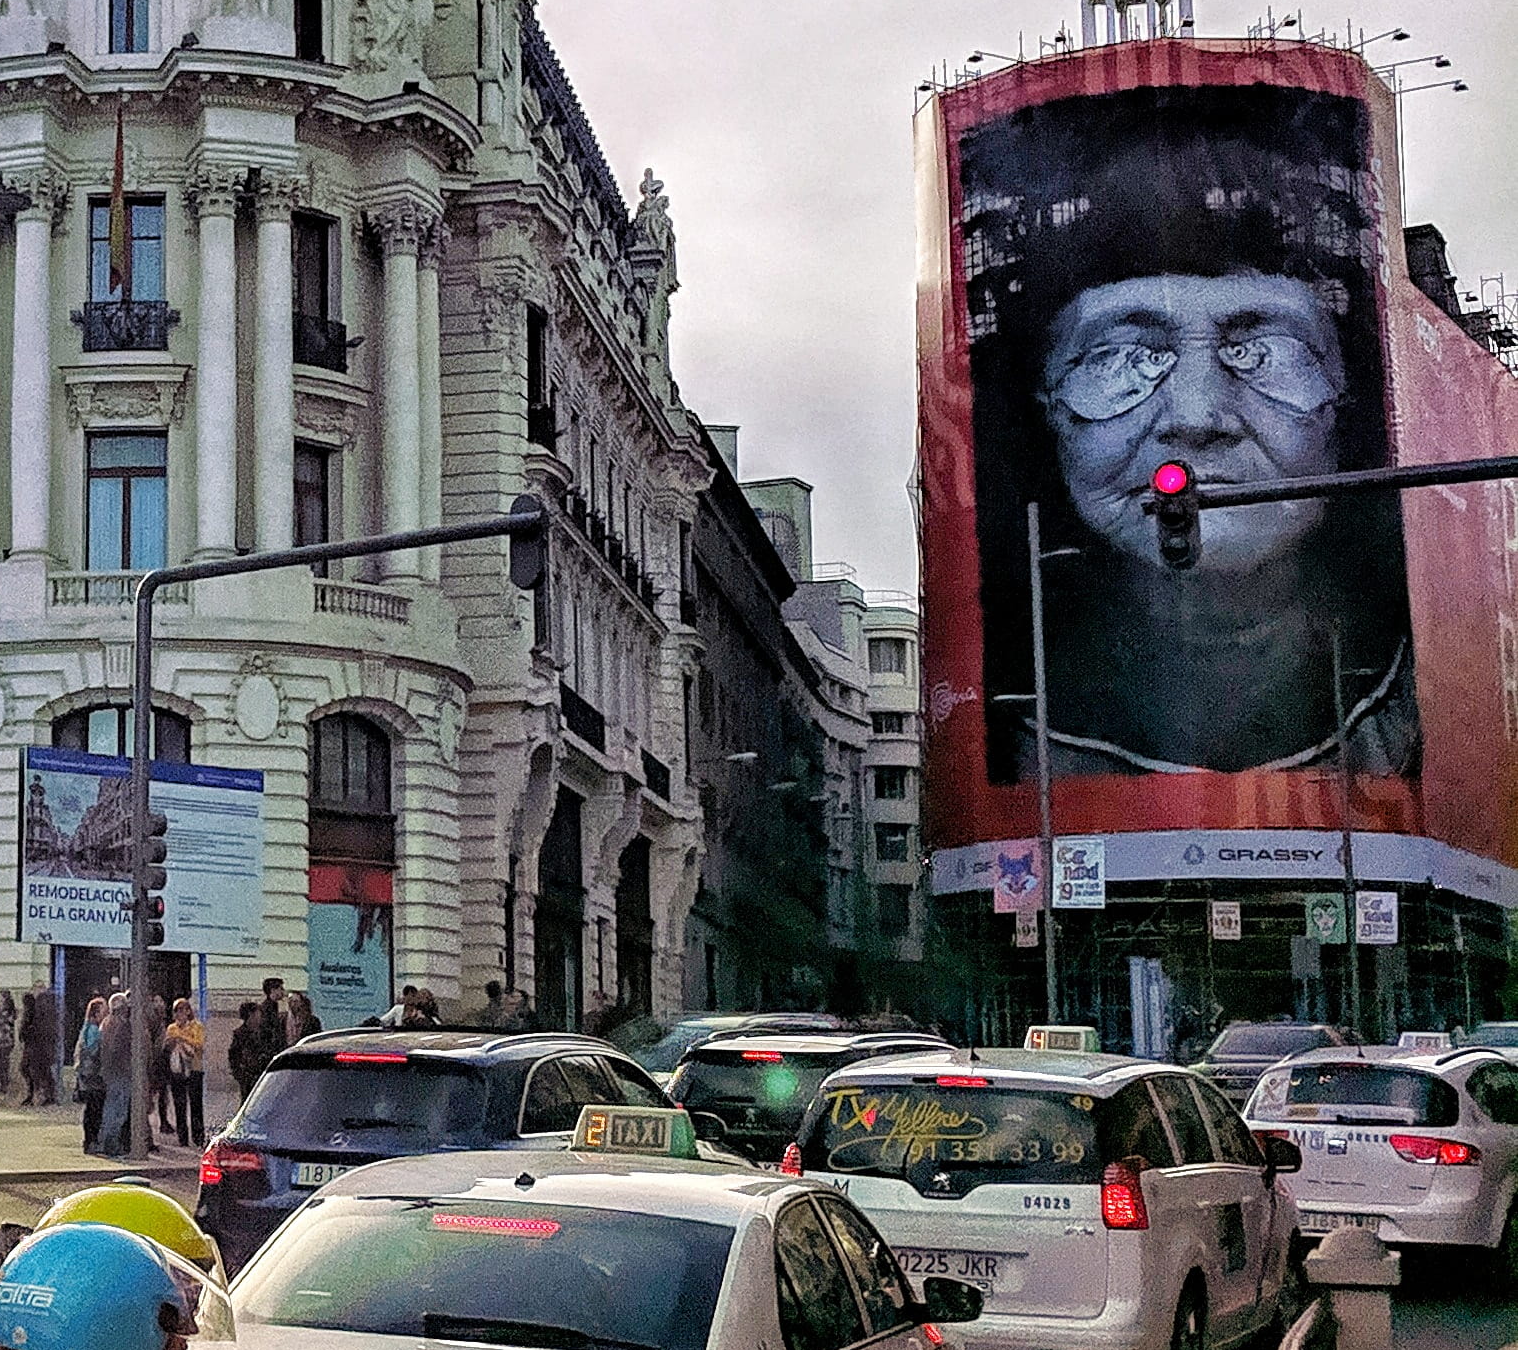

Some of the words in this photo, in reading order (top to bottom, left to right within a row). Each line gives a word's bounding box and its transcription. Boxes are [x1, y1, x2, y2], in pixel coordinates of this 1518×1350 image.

[1218, 849, 1324, 862] GRASSY
[29, 905, 46, 919] DE
[49, 906, 65, 919] LA
[68, 908, 106, 923] GRAN
[1033, 1032, 1045, 1049] 4
[587, 1115, 606, 1145] 2
[614, 1118, 663, 1145] TAXI
[957, 1257, 998, 1278] JKR
